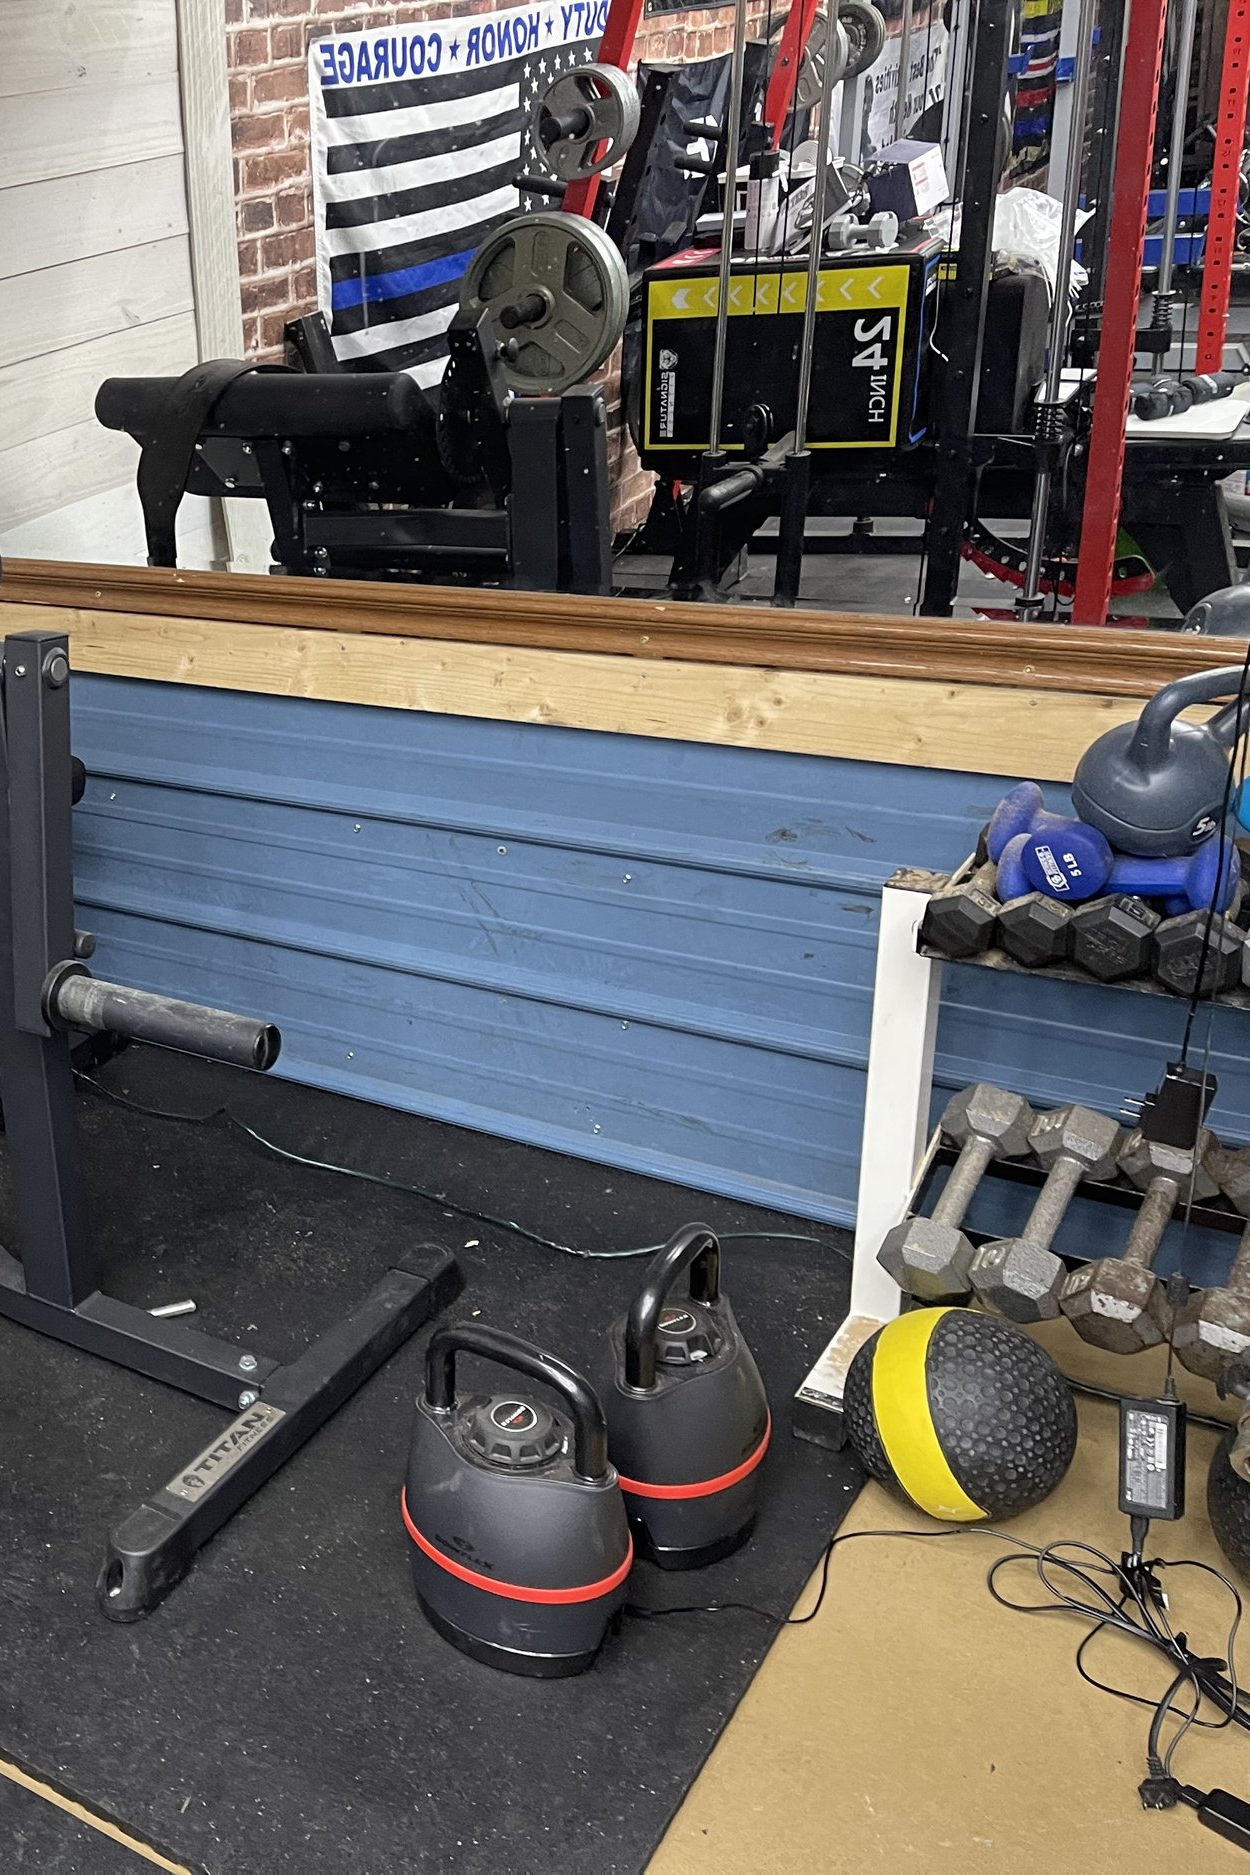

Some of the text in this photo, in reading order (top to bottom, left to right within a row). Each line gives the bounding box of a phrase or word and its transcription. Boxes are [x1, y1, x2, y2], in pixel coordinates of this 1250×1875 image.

[1062, 852, 1082, 877] 5 LB
[193, 1412, 266, 1472] TITAN
[236, 1415, 276, 1452] FITNESS
